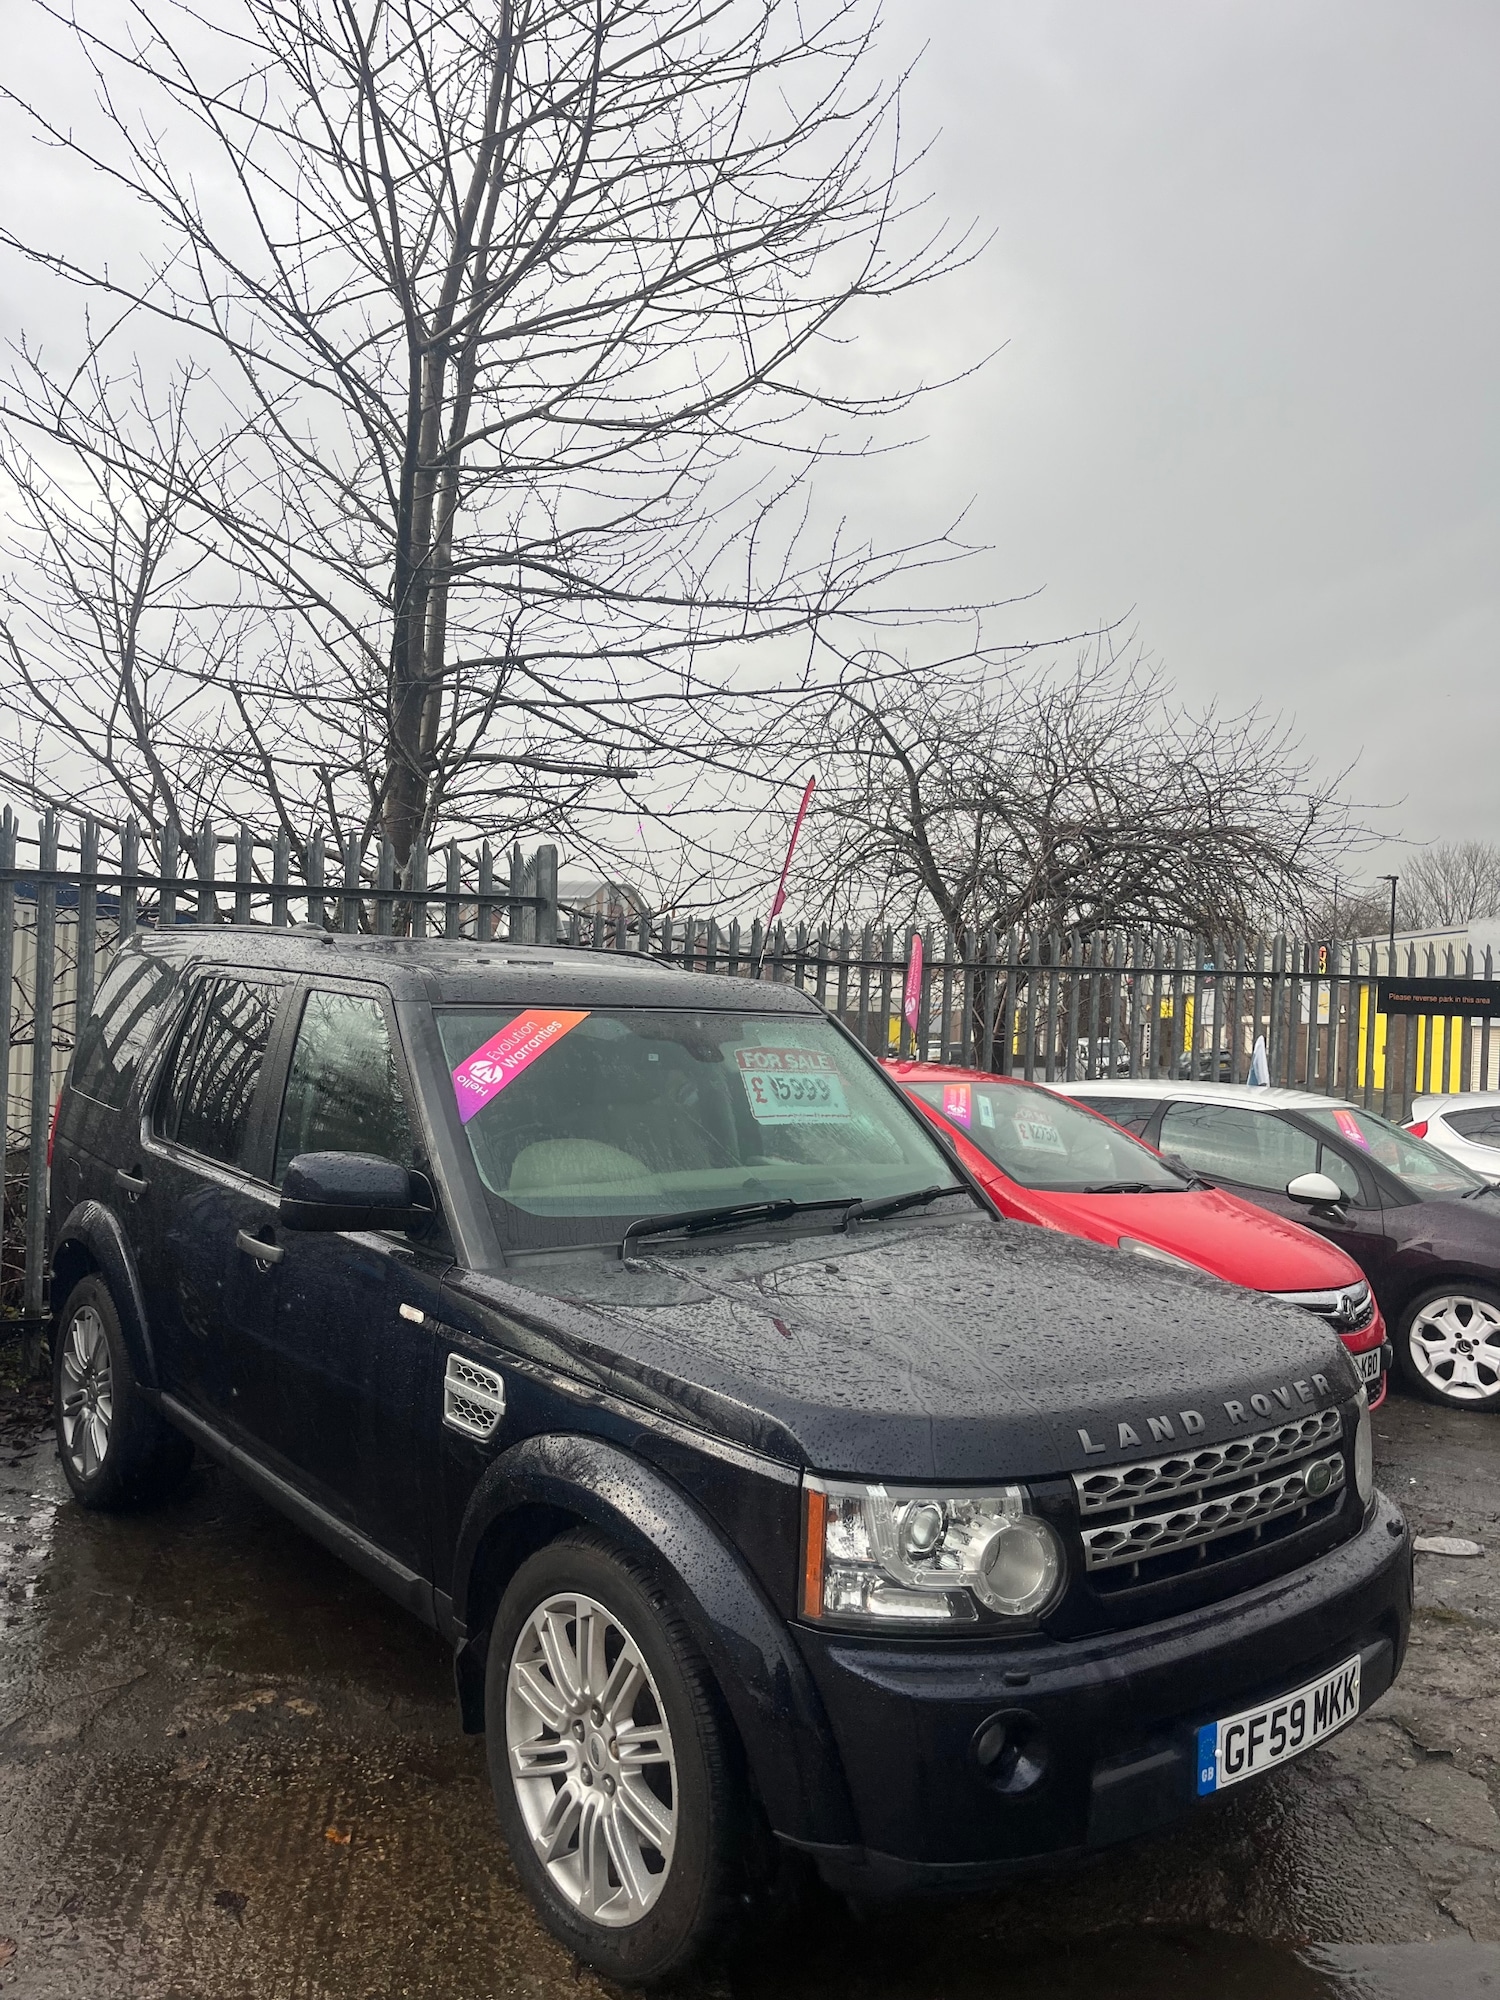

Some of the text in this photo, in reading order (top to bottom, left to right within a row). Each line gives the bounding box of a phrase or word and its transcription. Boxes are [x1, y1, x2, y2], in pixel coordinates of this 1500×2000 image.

[1388, 992, 1412, 1001] Please
[1462, 996, 1474, 1004] this
[486, 1020, 538, 1061] Evolution
[501, 1020, 562, 1069] Warranties
[742, 1052, 831, 1069] FOR SALE
[456, 1075, 488, 1096] Hello
[1077, 1373, 1332, 1453] LAND ROVER
[1225, 1665, 1357, 1775] GF59 MKK
[1201, 1766, 1214, 1783] GB
